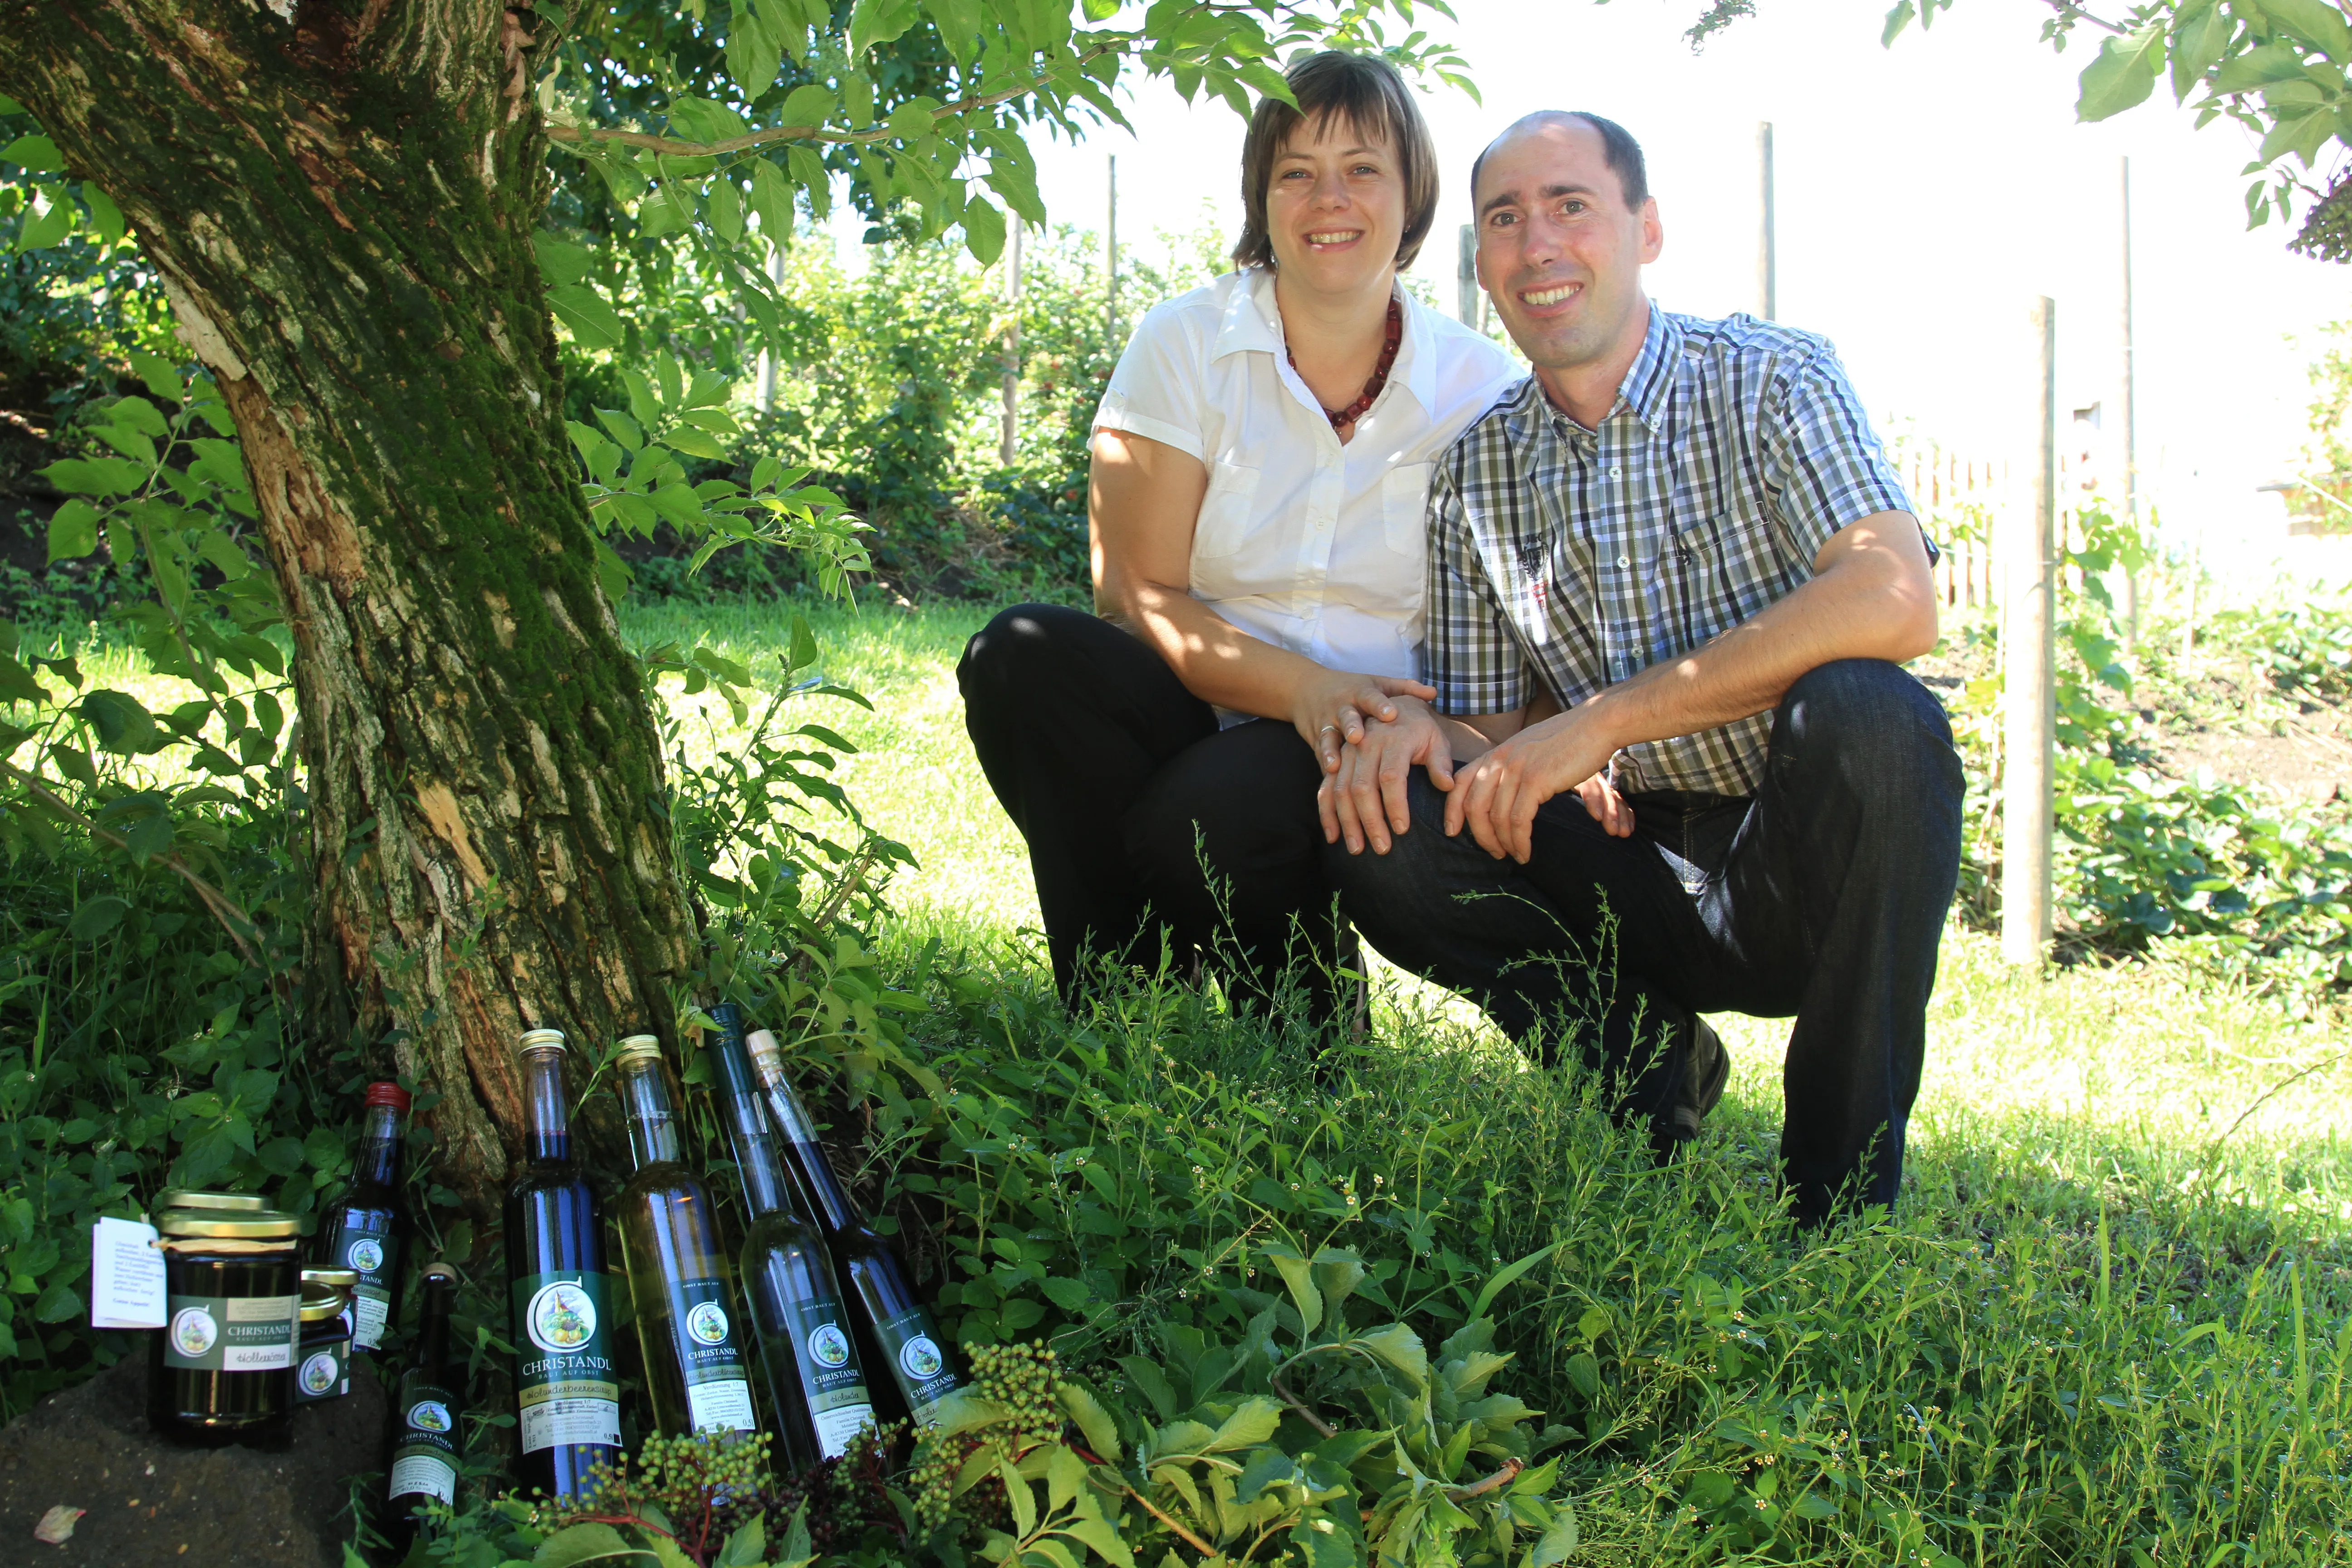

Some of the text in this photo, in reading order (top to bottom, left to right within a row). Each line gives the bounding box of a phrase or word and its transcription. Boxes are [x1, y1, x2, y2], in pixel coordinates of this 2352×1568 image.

[887, 1322, 899, 1330] OBST
[900, 1316, 912, 1324] BAUT
[228, 1324, 291, 1337] CHRISTANDL
[688, 1348, 738, 1360] CHRISTANDL
[523, 1356, 612, 1376] CHRISTANDL
[539, 1372, 559, 1380] BAUT
[813, 1369, 860, 1385] CHRISTANDL
[911, 1373, 957, 1399] CHRISTANDL
[921, 1391, 934, 1401] BAUT
[742, 1419, 754, 1427] 0,5l
